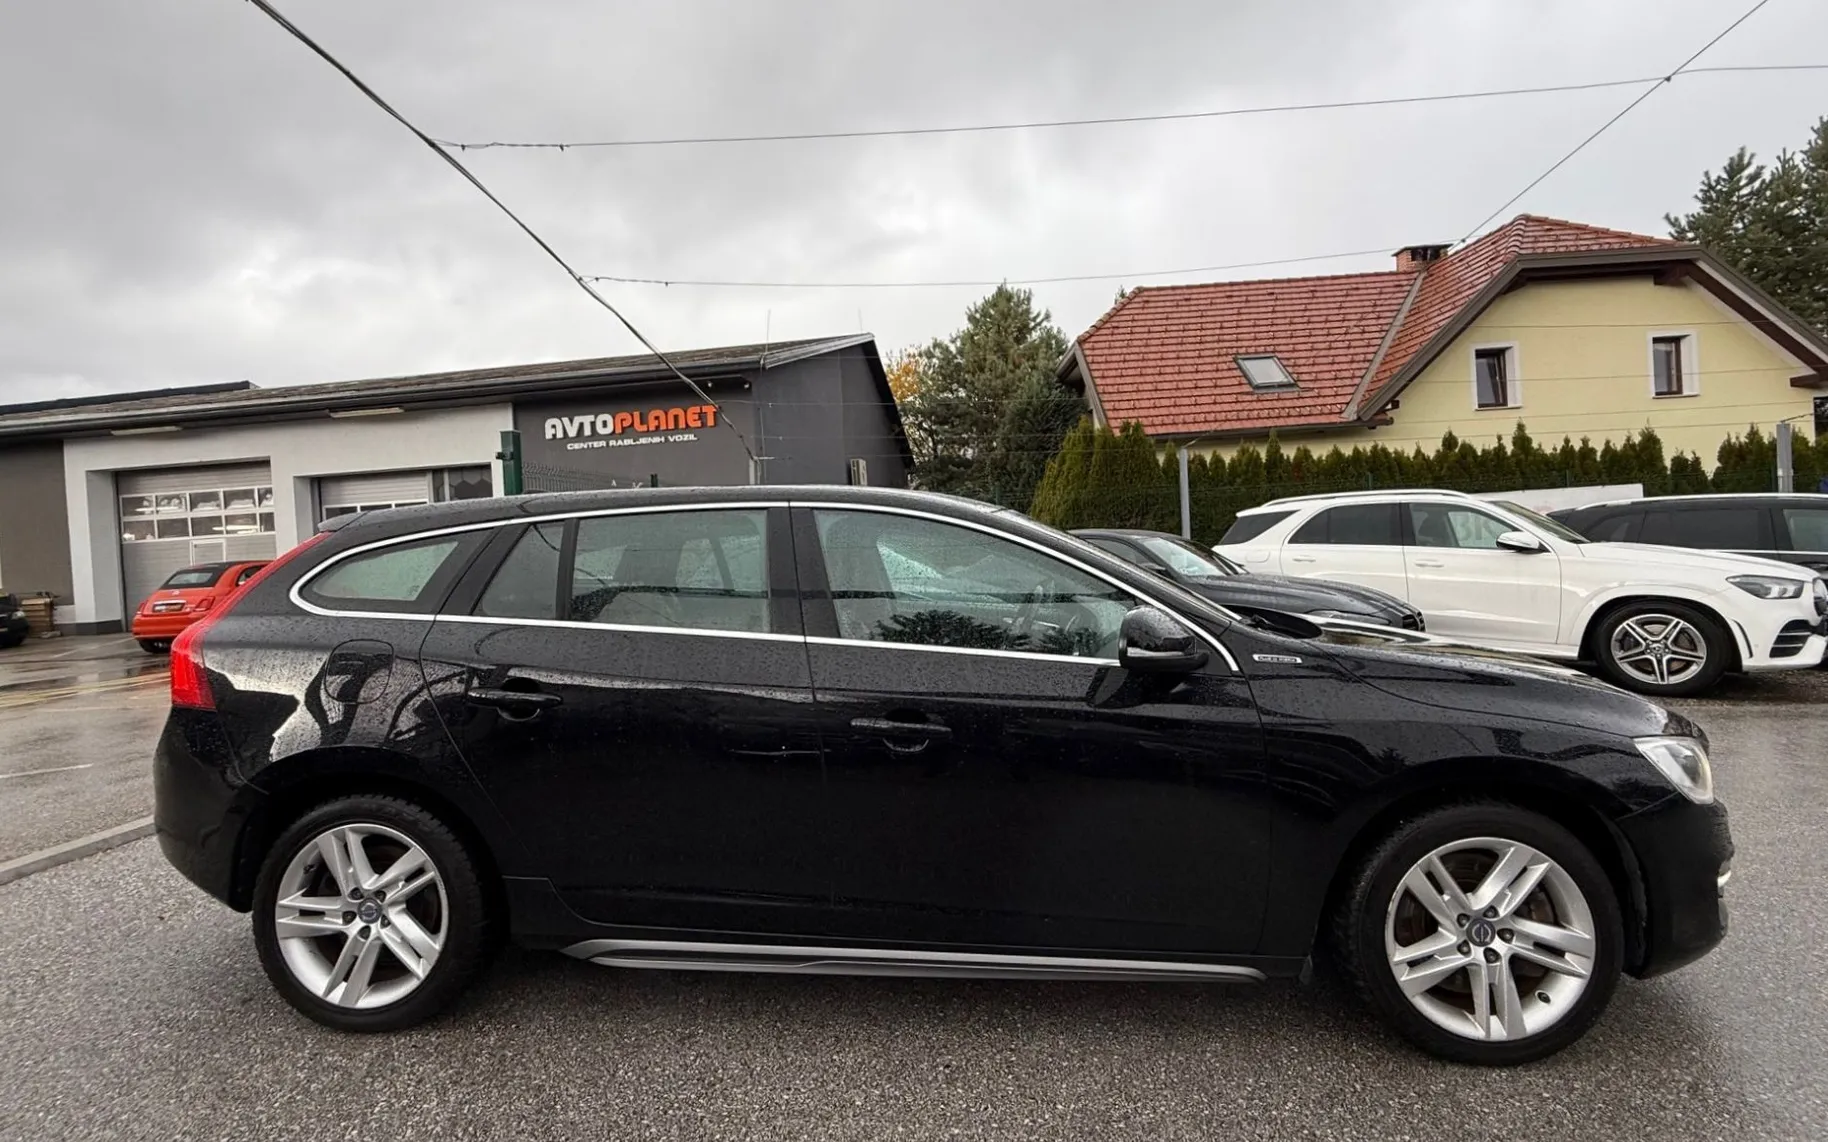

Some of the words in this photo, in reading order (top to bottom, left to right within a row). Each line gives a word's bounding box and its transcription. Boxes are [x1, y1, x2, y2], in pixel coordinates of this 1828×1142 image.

[566, 440, 607, 450] CENTER
[609, 436, 665, 447] RABLJENIH
[667, 433, 698, 442] VOZIL
